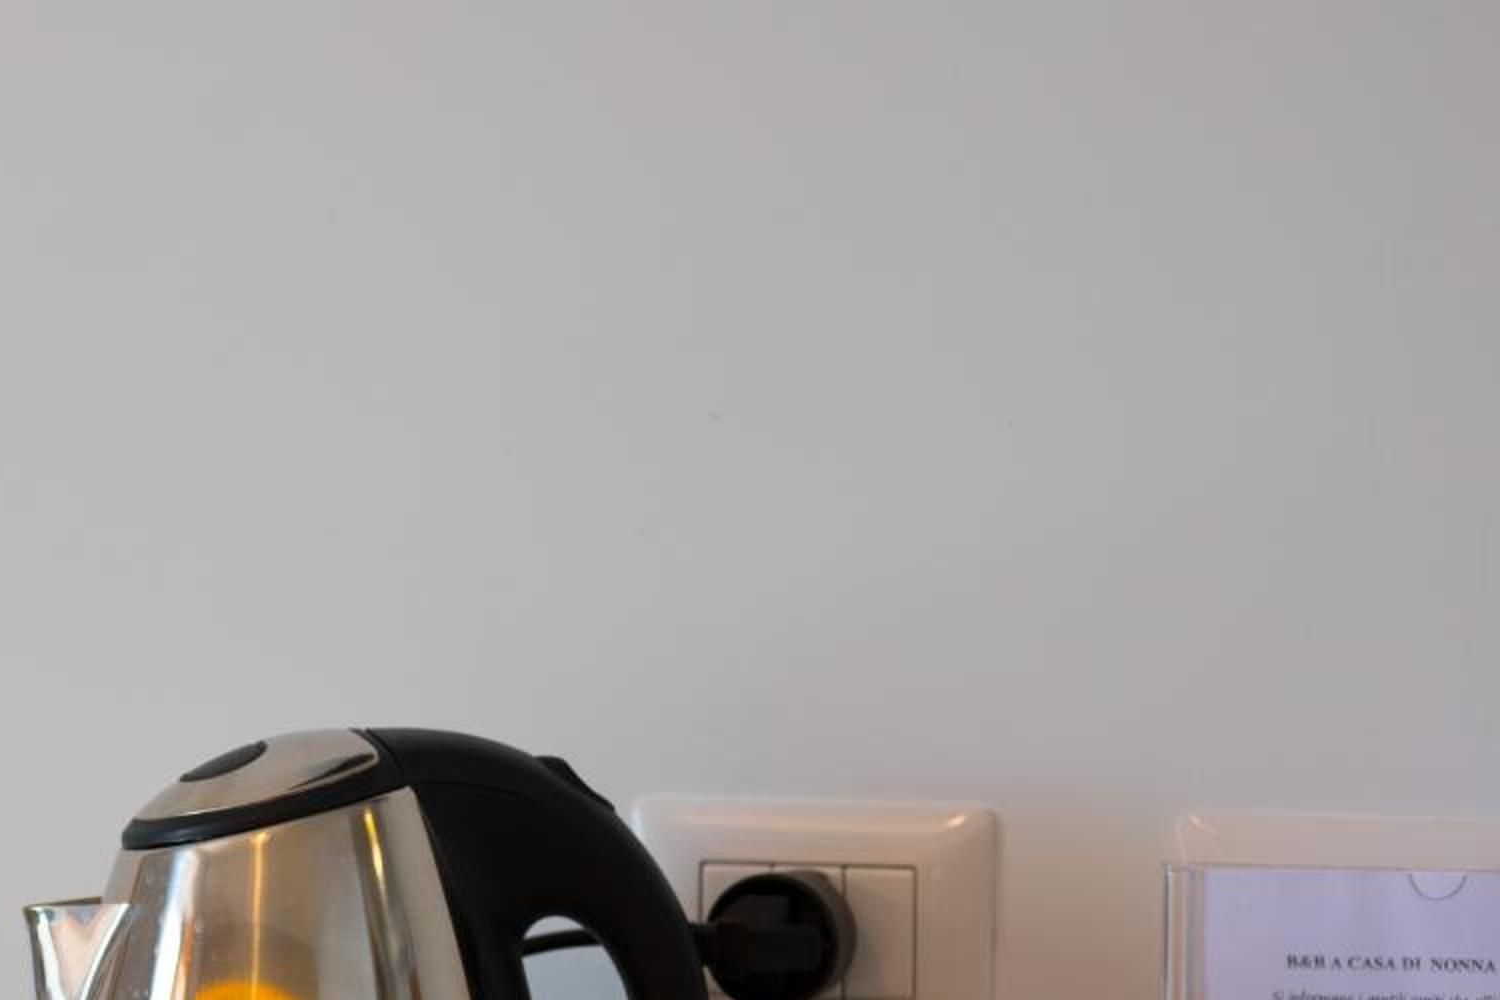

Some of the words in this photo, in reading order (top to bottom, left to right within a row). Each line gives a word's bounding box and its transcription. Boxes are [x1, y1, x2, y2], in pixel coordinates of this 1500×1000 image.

[1331, 955, 1343, 971] A
[1347, 955, 1397, 972] CASA
[1402, 956, 1422, 972] DI
[1430, 957, 1498, 974] NONNA
